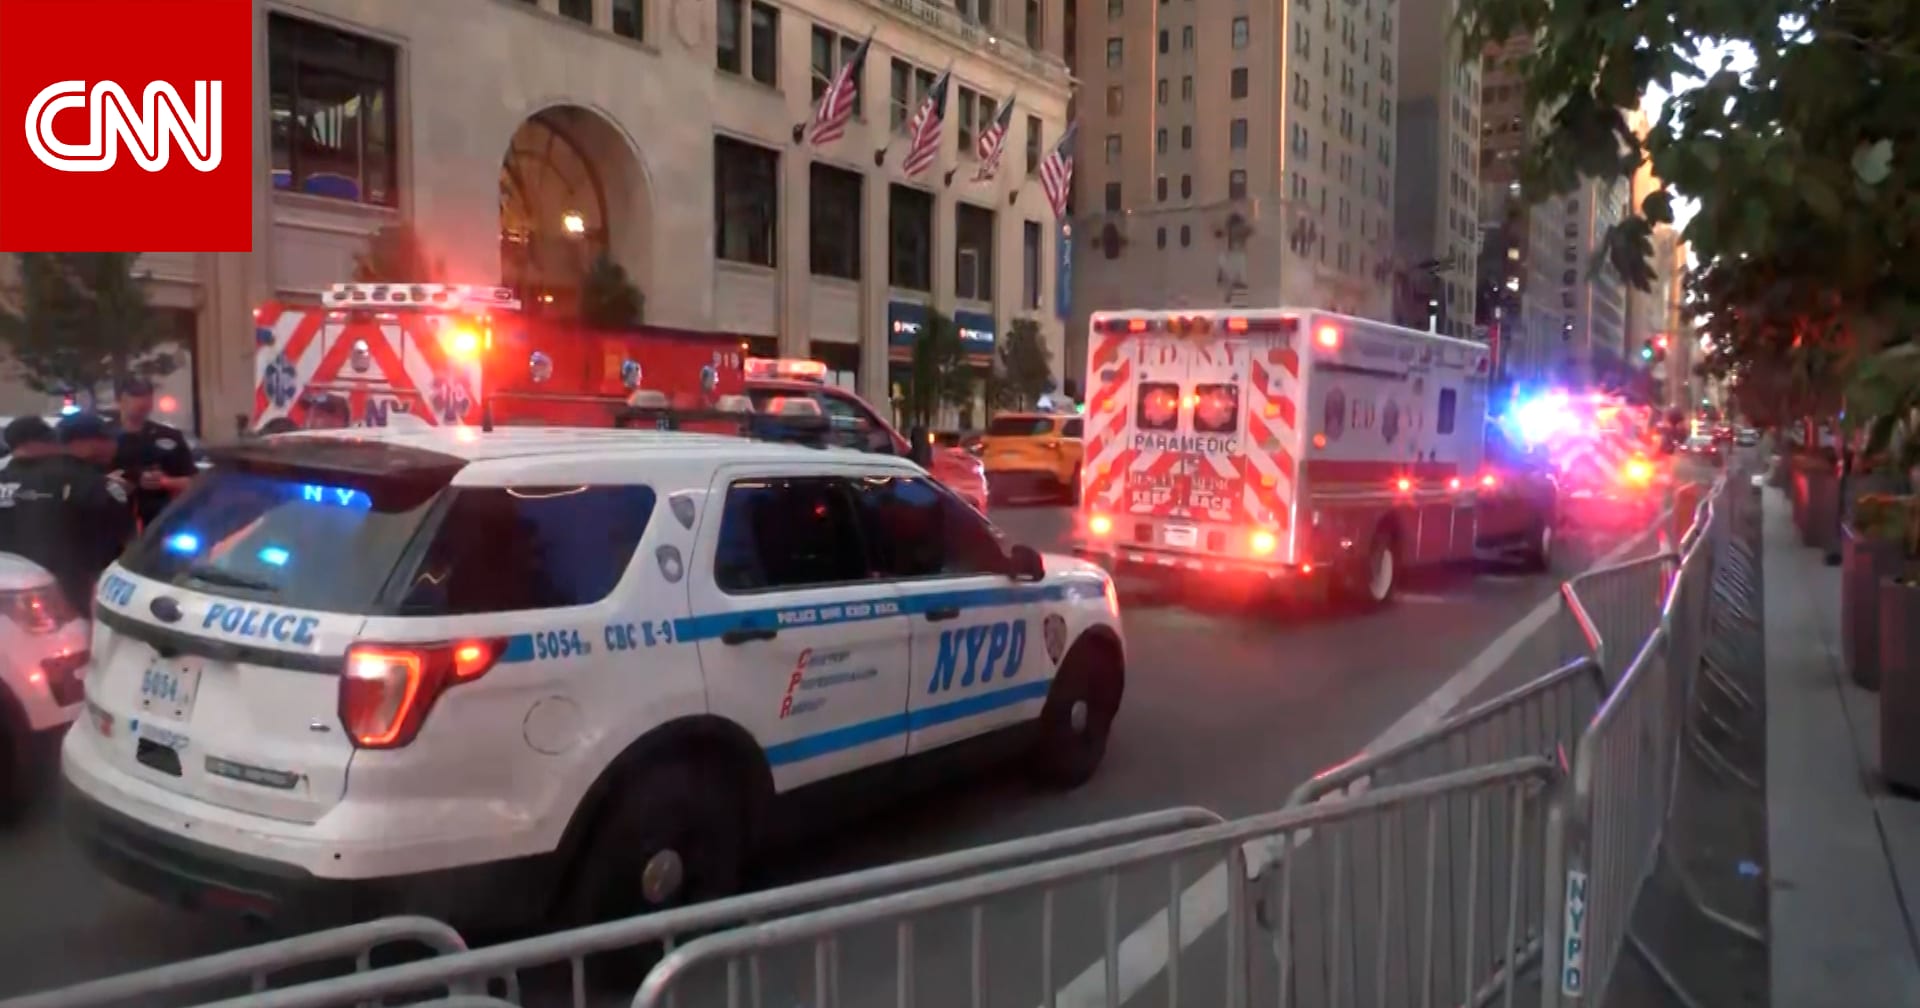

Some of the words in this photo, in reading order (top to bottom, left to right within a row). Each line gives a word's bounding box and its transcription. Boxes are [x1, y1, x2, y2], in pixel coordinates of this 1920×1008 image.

[1134, 434, 1239, 454] PARAMEDIC
[202, 603, 320, 647] POLICE
[536, 629, 581, 660] 5054
[928, 619, 1026, 694] NYPD
[1566, 879, 1587, 992] NYPD
